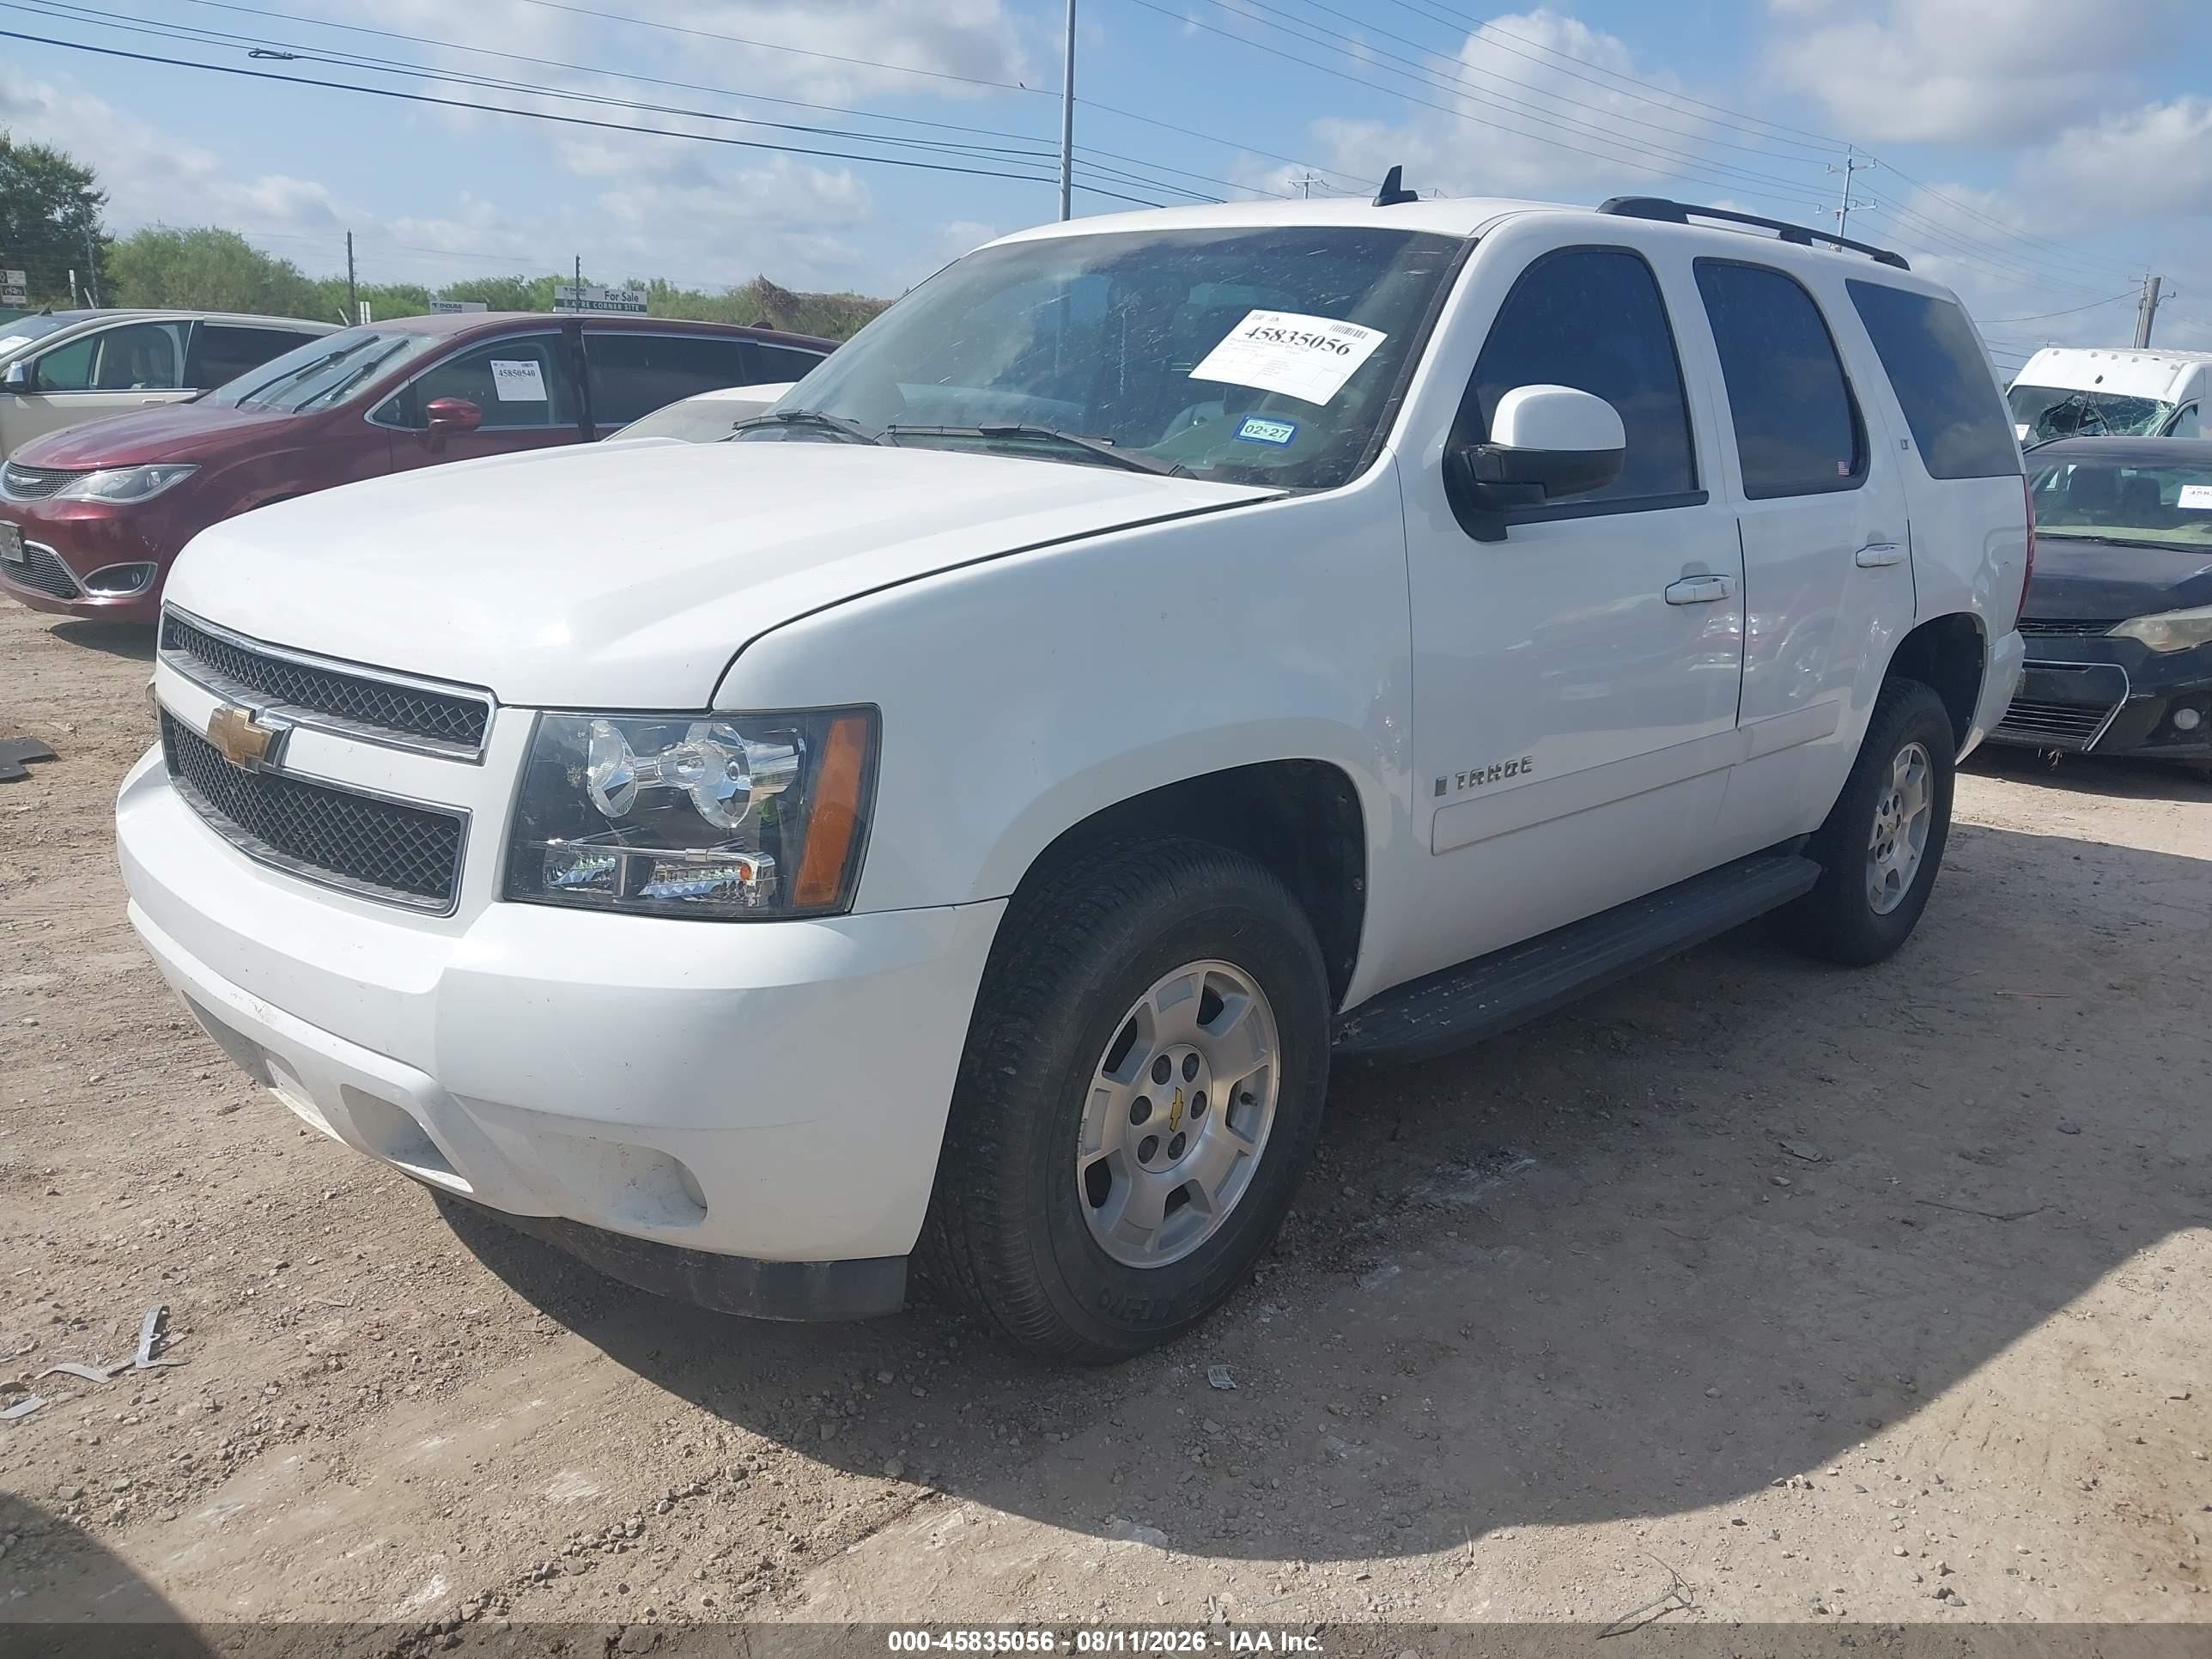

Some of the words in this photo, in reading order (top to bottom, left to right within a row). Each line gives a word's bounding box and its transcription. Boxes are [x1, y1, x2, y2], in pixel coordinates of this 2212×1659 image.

[604, 290, 619, 301] For
[622, 292, 639, 302] Sale
[571, 300, 590, 308] ARE
[1244, 326, 1355, 356] 45835056
[499, 369, 536, 378] 45850540
[1455, 755, 1533, 790] TAHOE
